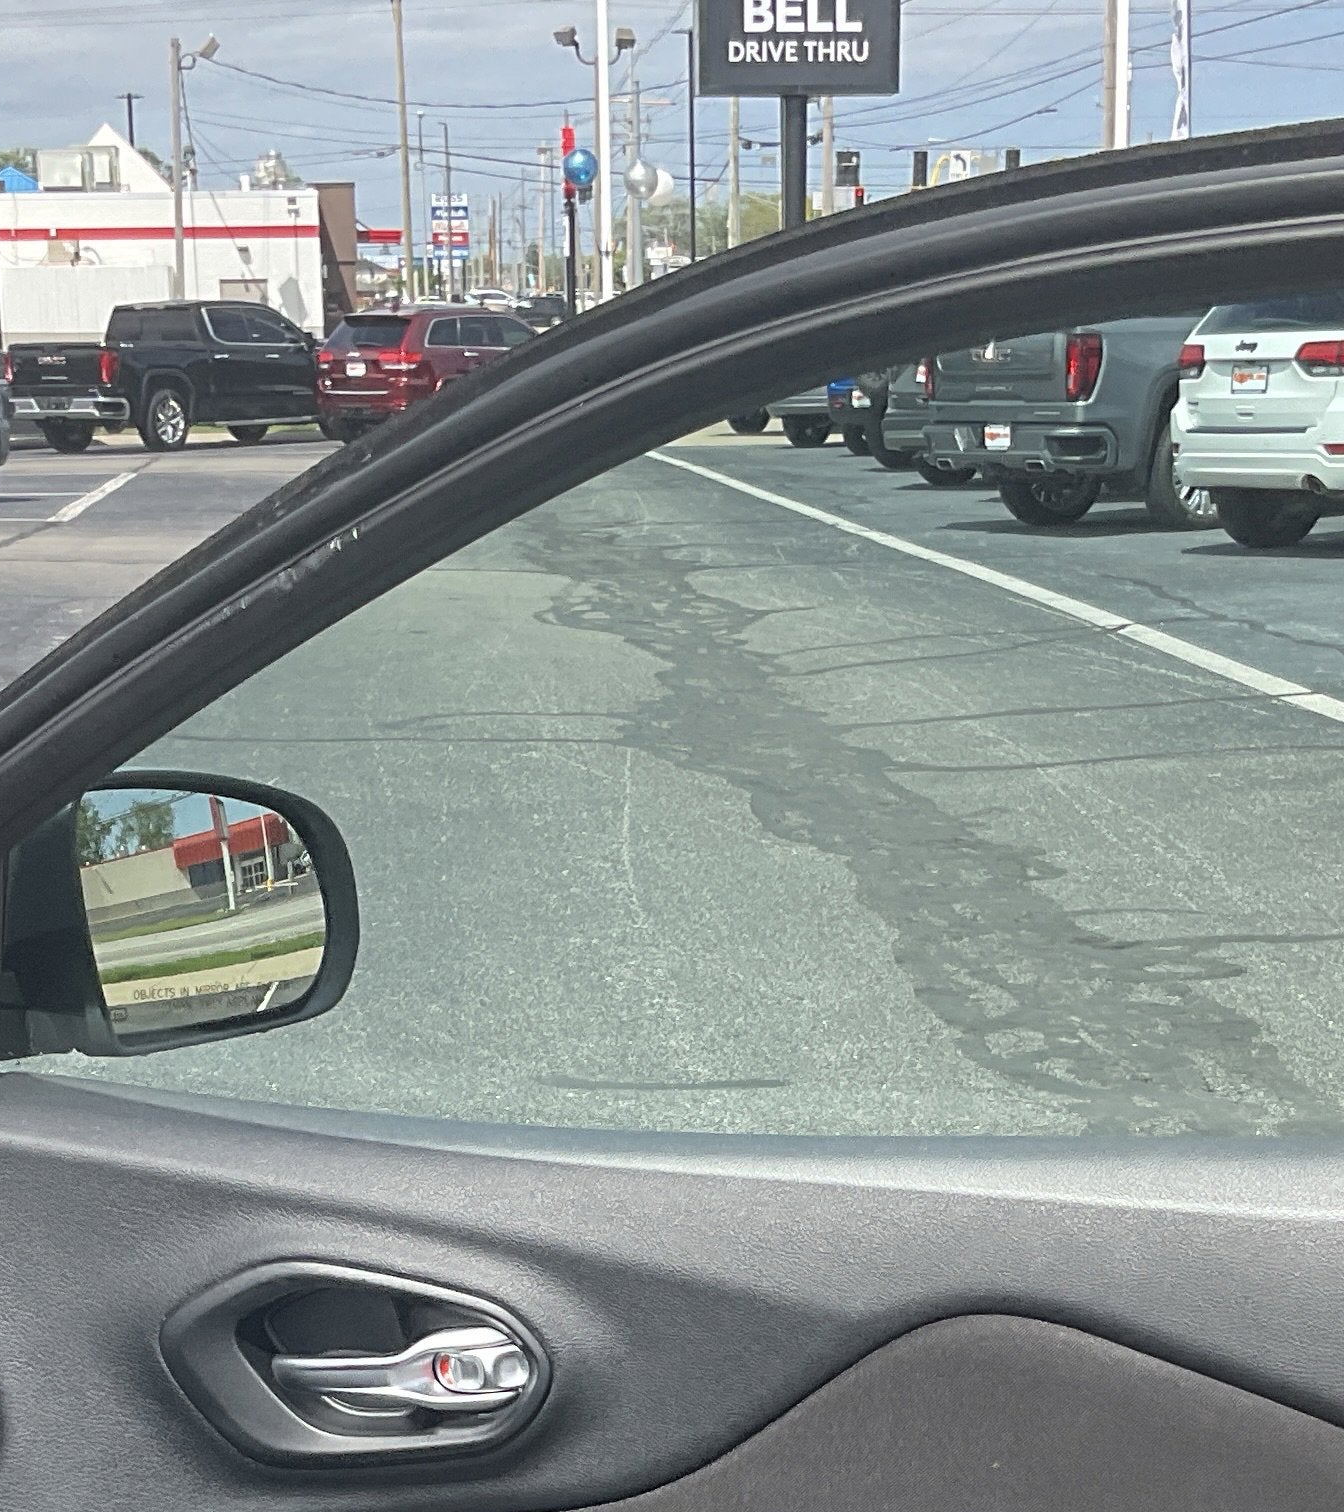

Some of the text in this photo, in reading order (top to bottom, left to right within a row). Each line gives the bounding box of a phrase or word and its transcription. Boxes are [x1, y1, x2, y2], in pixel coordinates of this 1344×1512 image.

[743, 0, 863, 33] BELL
[728, 39, 869, 63] DRIVE THRU
[133, 986, 175, 1001] OBJECTS
[179, 985, 190, 998] IN
